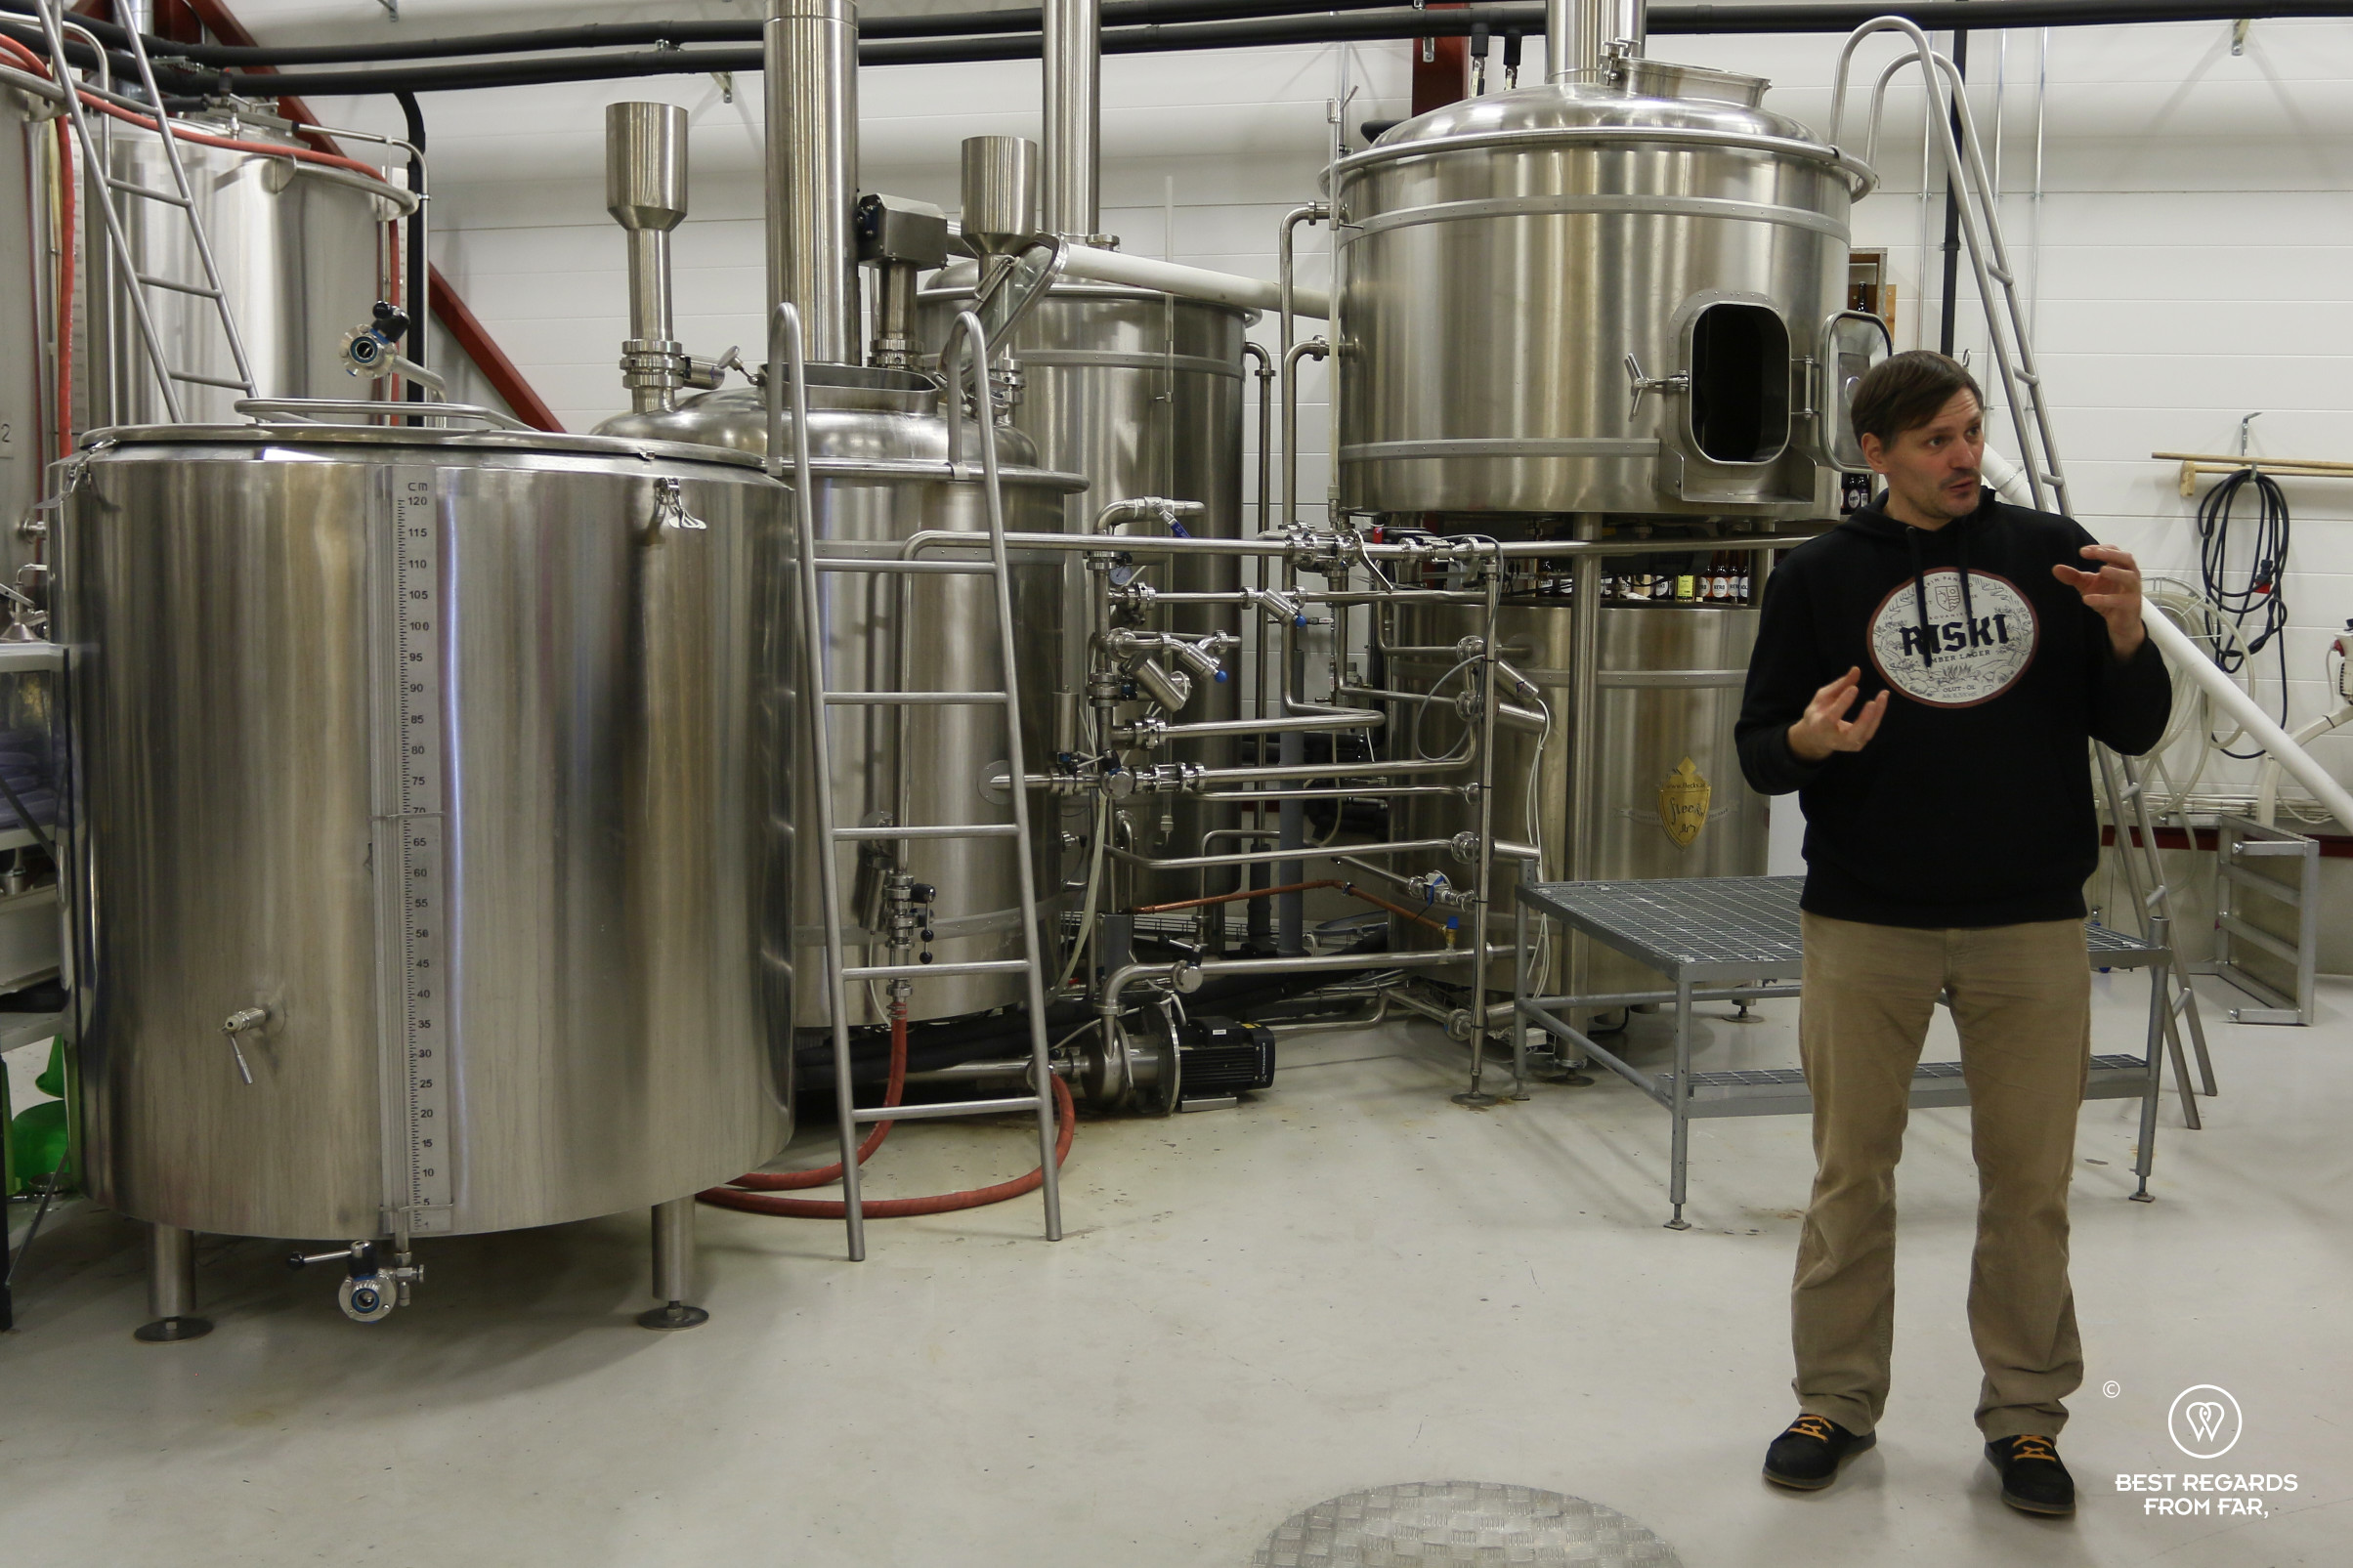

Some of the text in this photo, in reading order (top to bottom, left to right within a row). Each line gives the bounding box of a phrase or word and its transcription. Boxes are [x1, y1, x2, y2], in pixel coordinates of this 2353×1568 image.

[408, 496, 427, 506] 120
[408, 529, 428, 537] 115
[408, 560, 427, 569] 110
[408, 590, 429, 600] 105
[409, 621, 429, 631] 100
[1899, 614, 2009, 657] RISKI
[409, 653, 423, 661] 95
[1932, 649, 1990, 663] MBER LAGER
[409, 684, 423, 693] 90
[410, 715, 424, 724] 85
[411, 745, 425, 754] 80
[412, 777, 425, 785] 75
[413, 837, 427, 847] 65
[413, 869, 427, 877] 60
[415, 899, 428, 908] 55
[415, 929, 429, 938] 50
[416, 959, 430, 968] 45
[417, 990, 431, 998] 40
[418, 1020, 431, 1029] 35
[419, 1049, 432, 1058] 30
[420, 1080, 433, 1088] 25
[421, 1109, 433, 1118] 20
[422, 1139, 433, 1148] 15
[423, 1168, 434, 1177] 10
